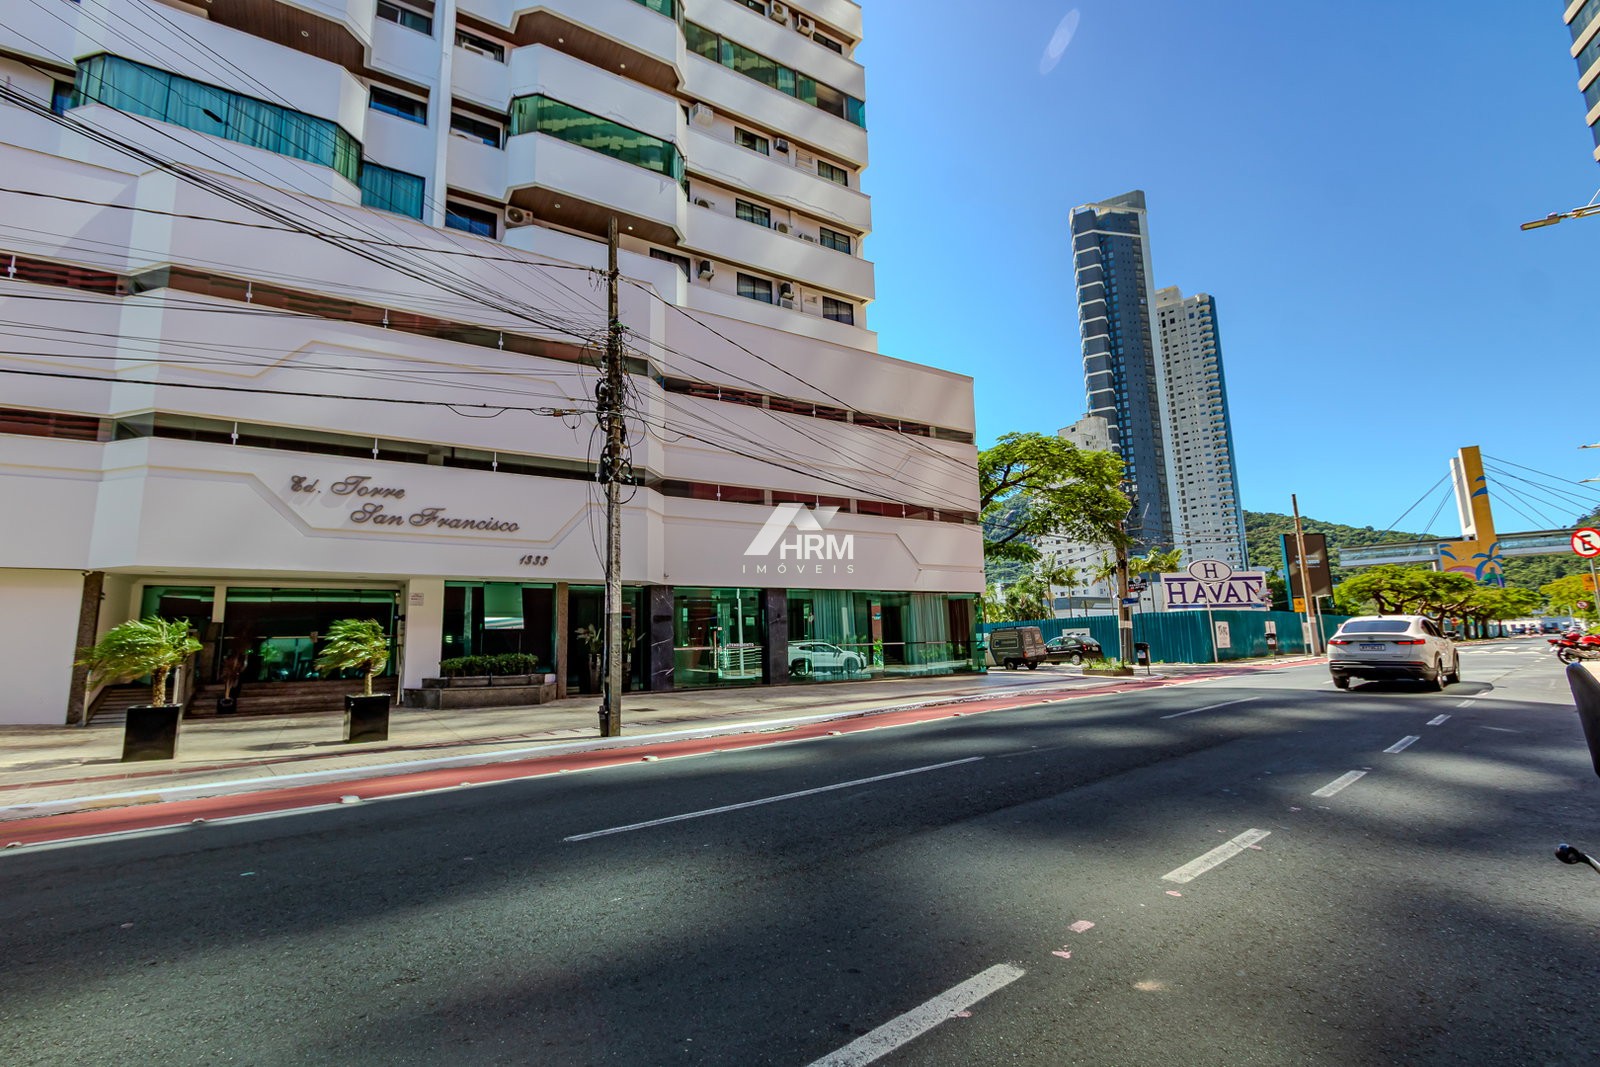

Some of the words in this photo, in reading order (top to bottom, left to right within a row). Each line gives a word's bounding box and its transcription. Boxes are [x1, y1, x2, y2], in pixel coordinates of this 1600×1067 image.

[291, 475, 321, 493] Ed.
[331, 475, 405, 499] Torre
[350, 502, 404, 526] San
[408, 507, 520, 533] Francisco
[1202, 563, 1219, 579] H
[1165, 581, 1264, 604] HAVAN
